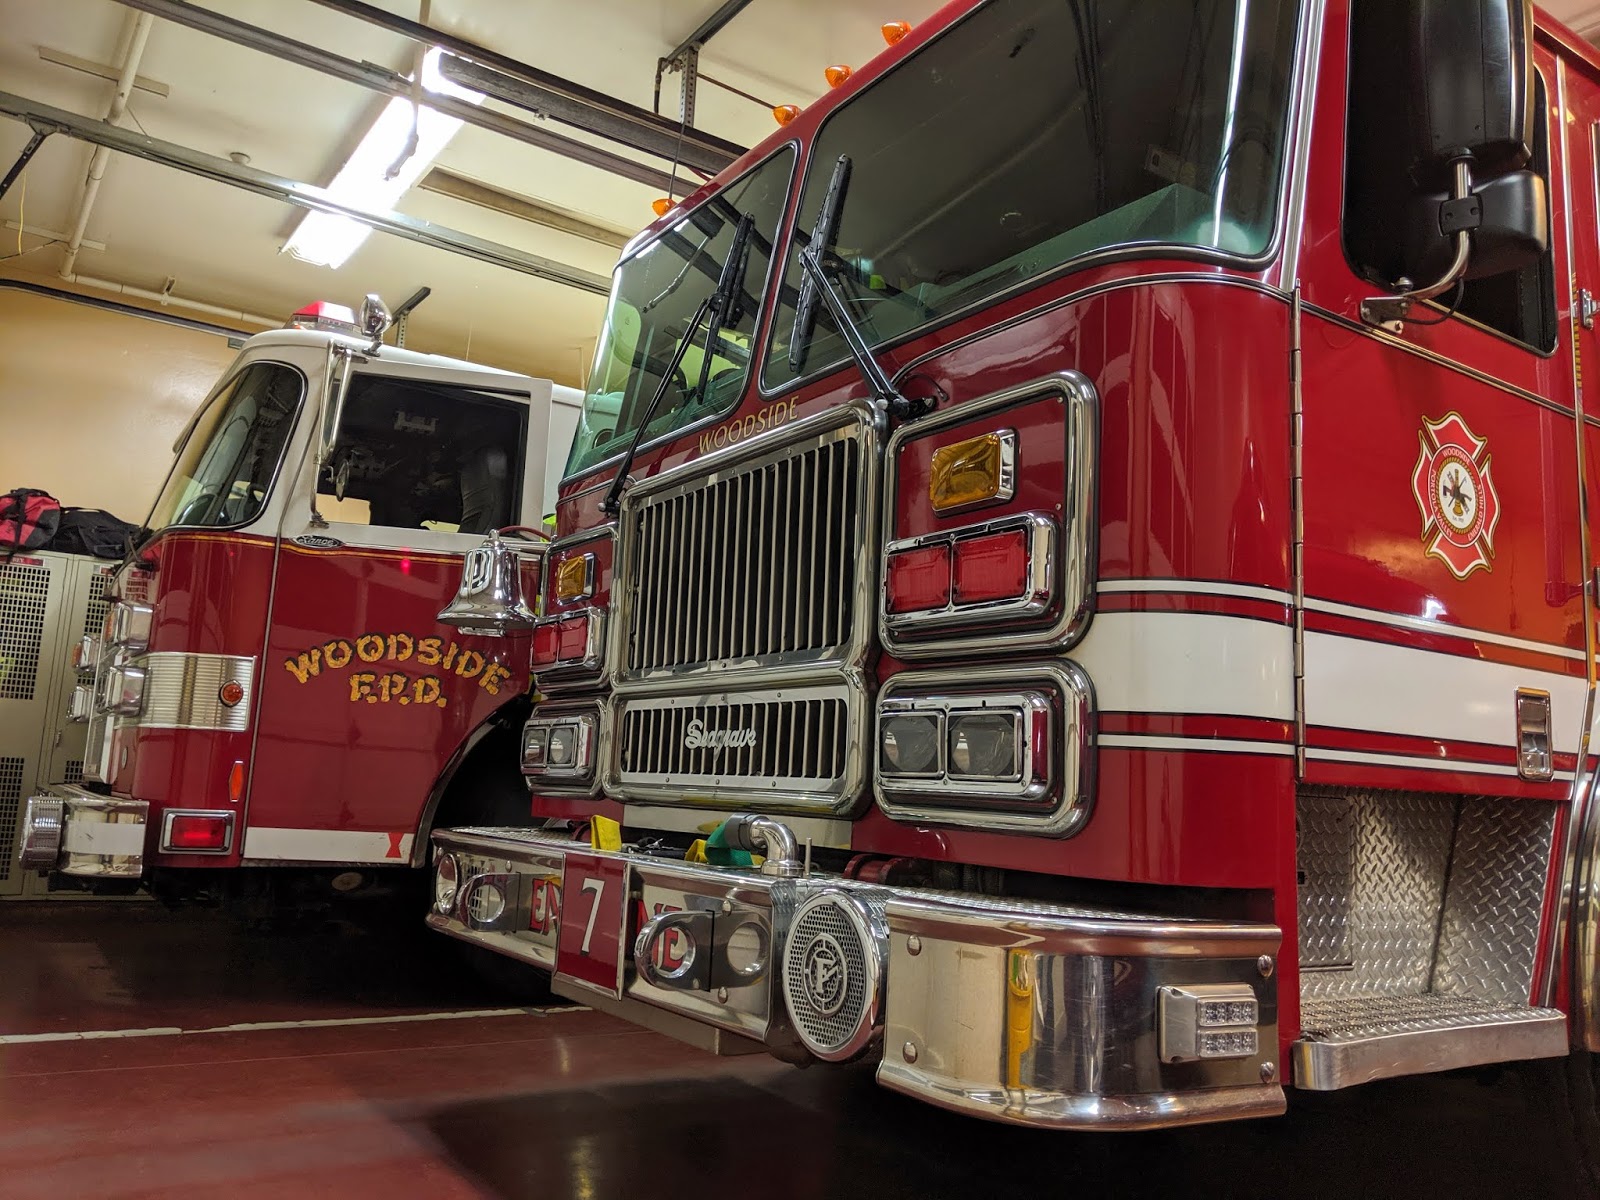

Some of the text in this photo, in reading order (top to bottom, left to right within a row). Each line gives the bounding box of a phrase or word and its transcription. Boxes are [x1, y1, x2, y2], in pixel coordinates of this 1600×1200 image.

[698, 396, 799, 455] WOODSIDE
[1442, 447, 1471, 465] WOODSIDE
[1430, 469, 1454, 538] PORTOLA VALLEY
[1468, 511, 1484, 541] EMERALD
[285, 633, 511, 696] WOODSIDE
[581, 877, 606, 955] 7
